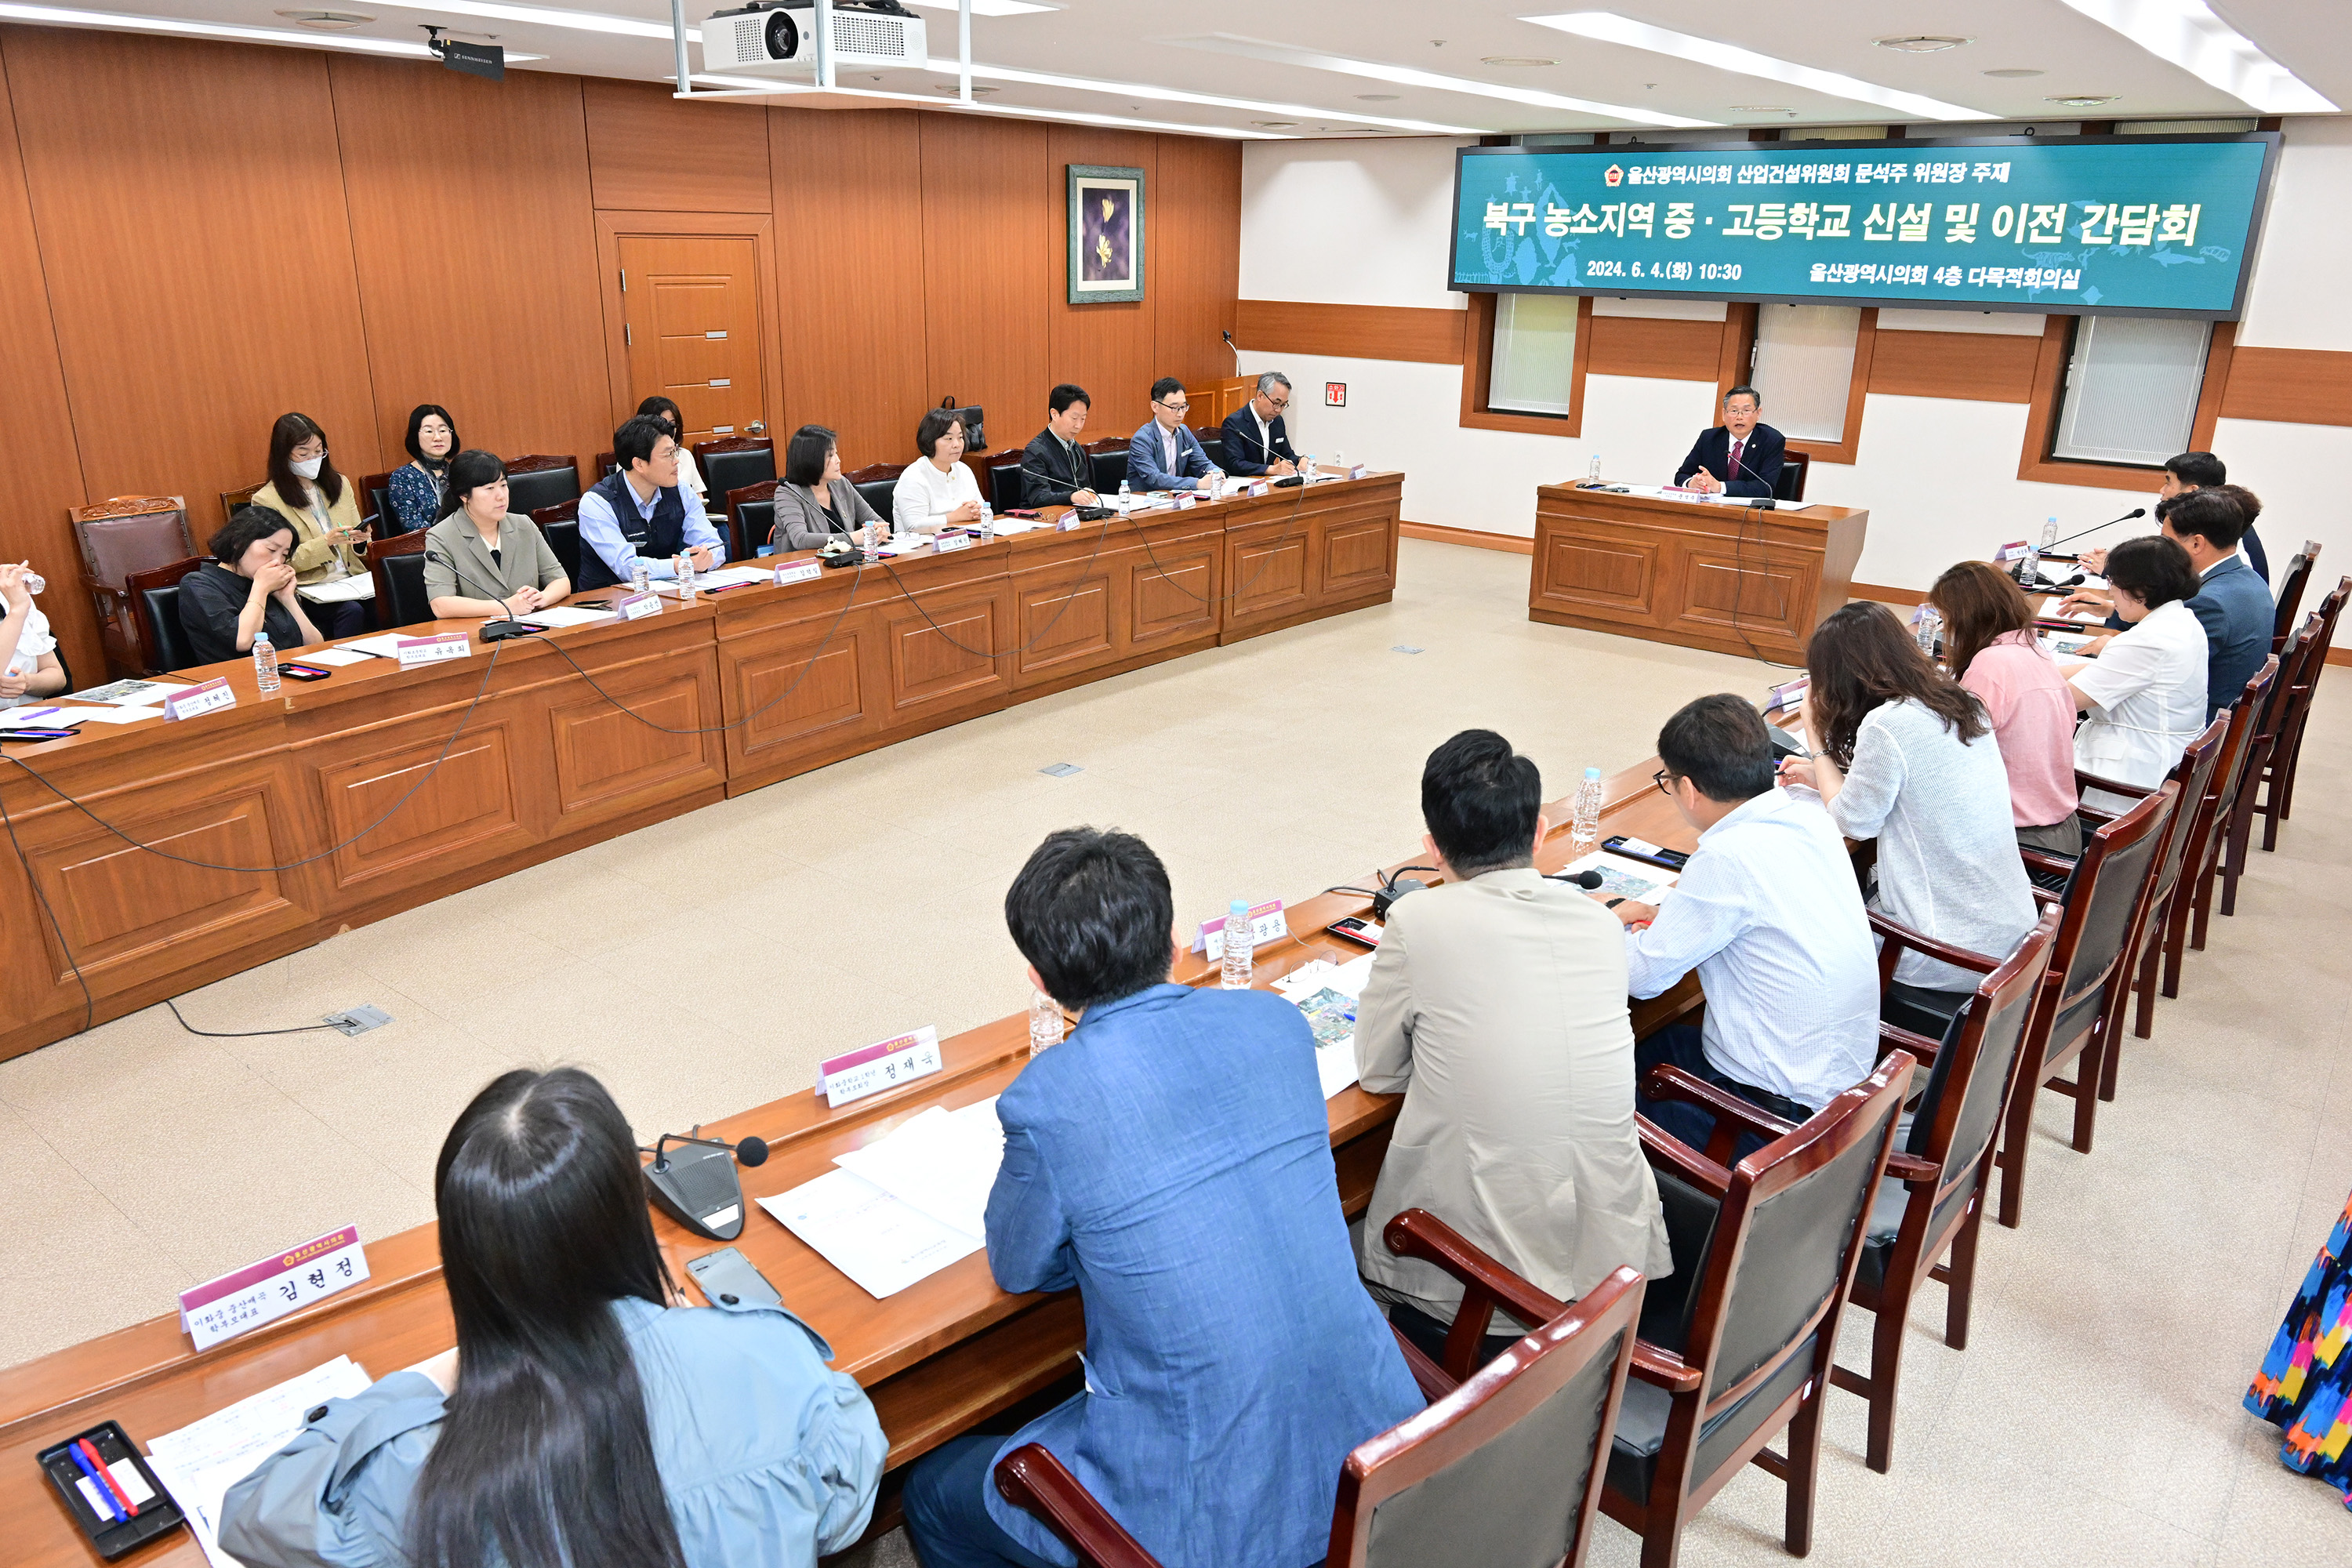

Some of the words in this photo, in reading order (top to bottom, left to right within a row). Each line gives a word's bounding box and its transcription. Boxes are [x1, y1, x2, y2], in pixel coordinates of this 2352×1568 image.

[462, 55, 492, 64] SENNHEISER
[1628, 165, 1732, 184] 울산광역시의회
[1737, 164, 1851, 183] 산업건설위원회
[1855, 163, 1908, 183] 문석주
[1913, 162, 1968, 183] 위원장
[1972, 162, 2011, 183] 주재
[1483, 202, 1537, 236] 북구
[1544, 202, 1656, 238] 농소지역
[1664, 202, 1695, 238] 중
[1722, 202, 1851, 240] 고등학교
[1863, 203, 1933, 241] 신설
[1944, 203, 1980, 243] 및
[1991, 203, 2067, 244] 이전
[2080, 203, 2201, 246] 간담회
[1587, 261, 1627, 278] 2024.
[1632, 262, 1645, 278] 6.
[1650, 262, 1693, 280] 4.(화)
[1700, 264, 1742, 280] 10:30
[1809, 263, 1928, 285] 울산광역시의회
[1933, 267, 1963, 286] 4층
[1968, 267, 2082, 289] 다목적회의실
[1253, 919, 1281, 937] 광용
[885, 1051, 933, 1079] 정재욱
[280, 1258, 352, 1301] 김현정
